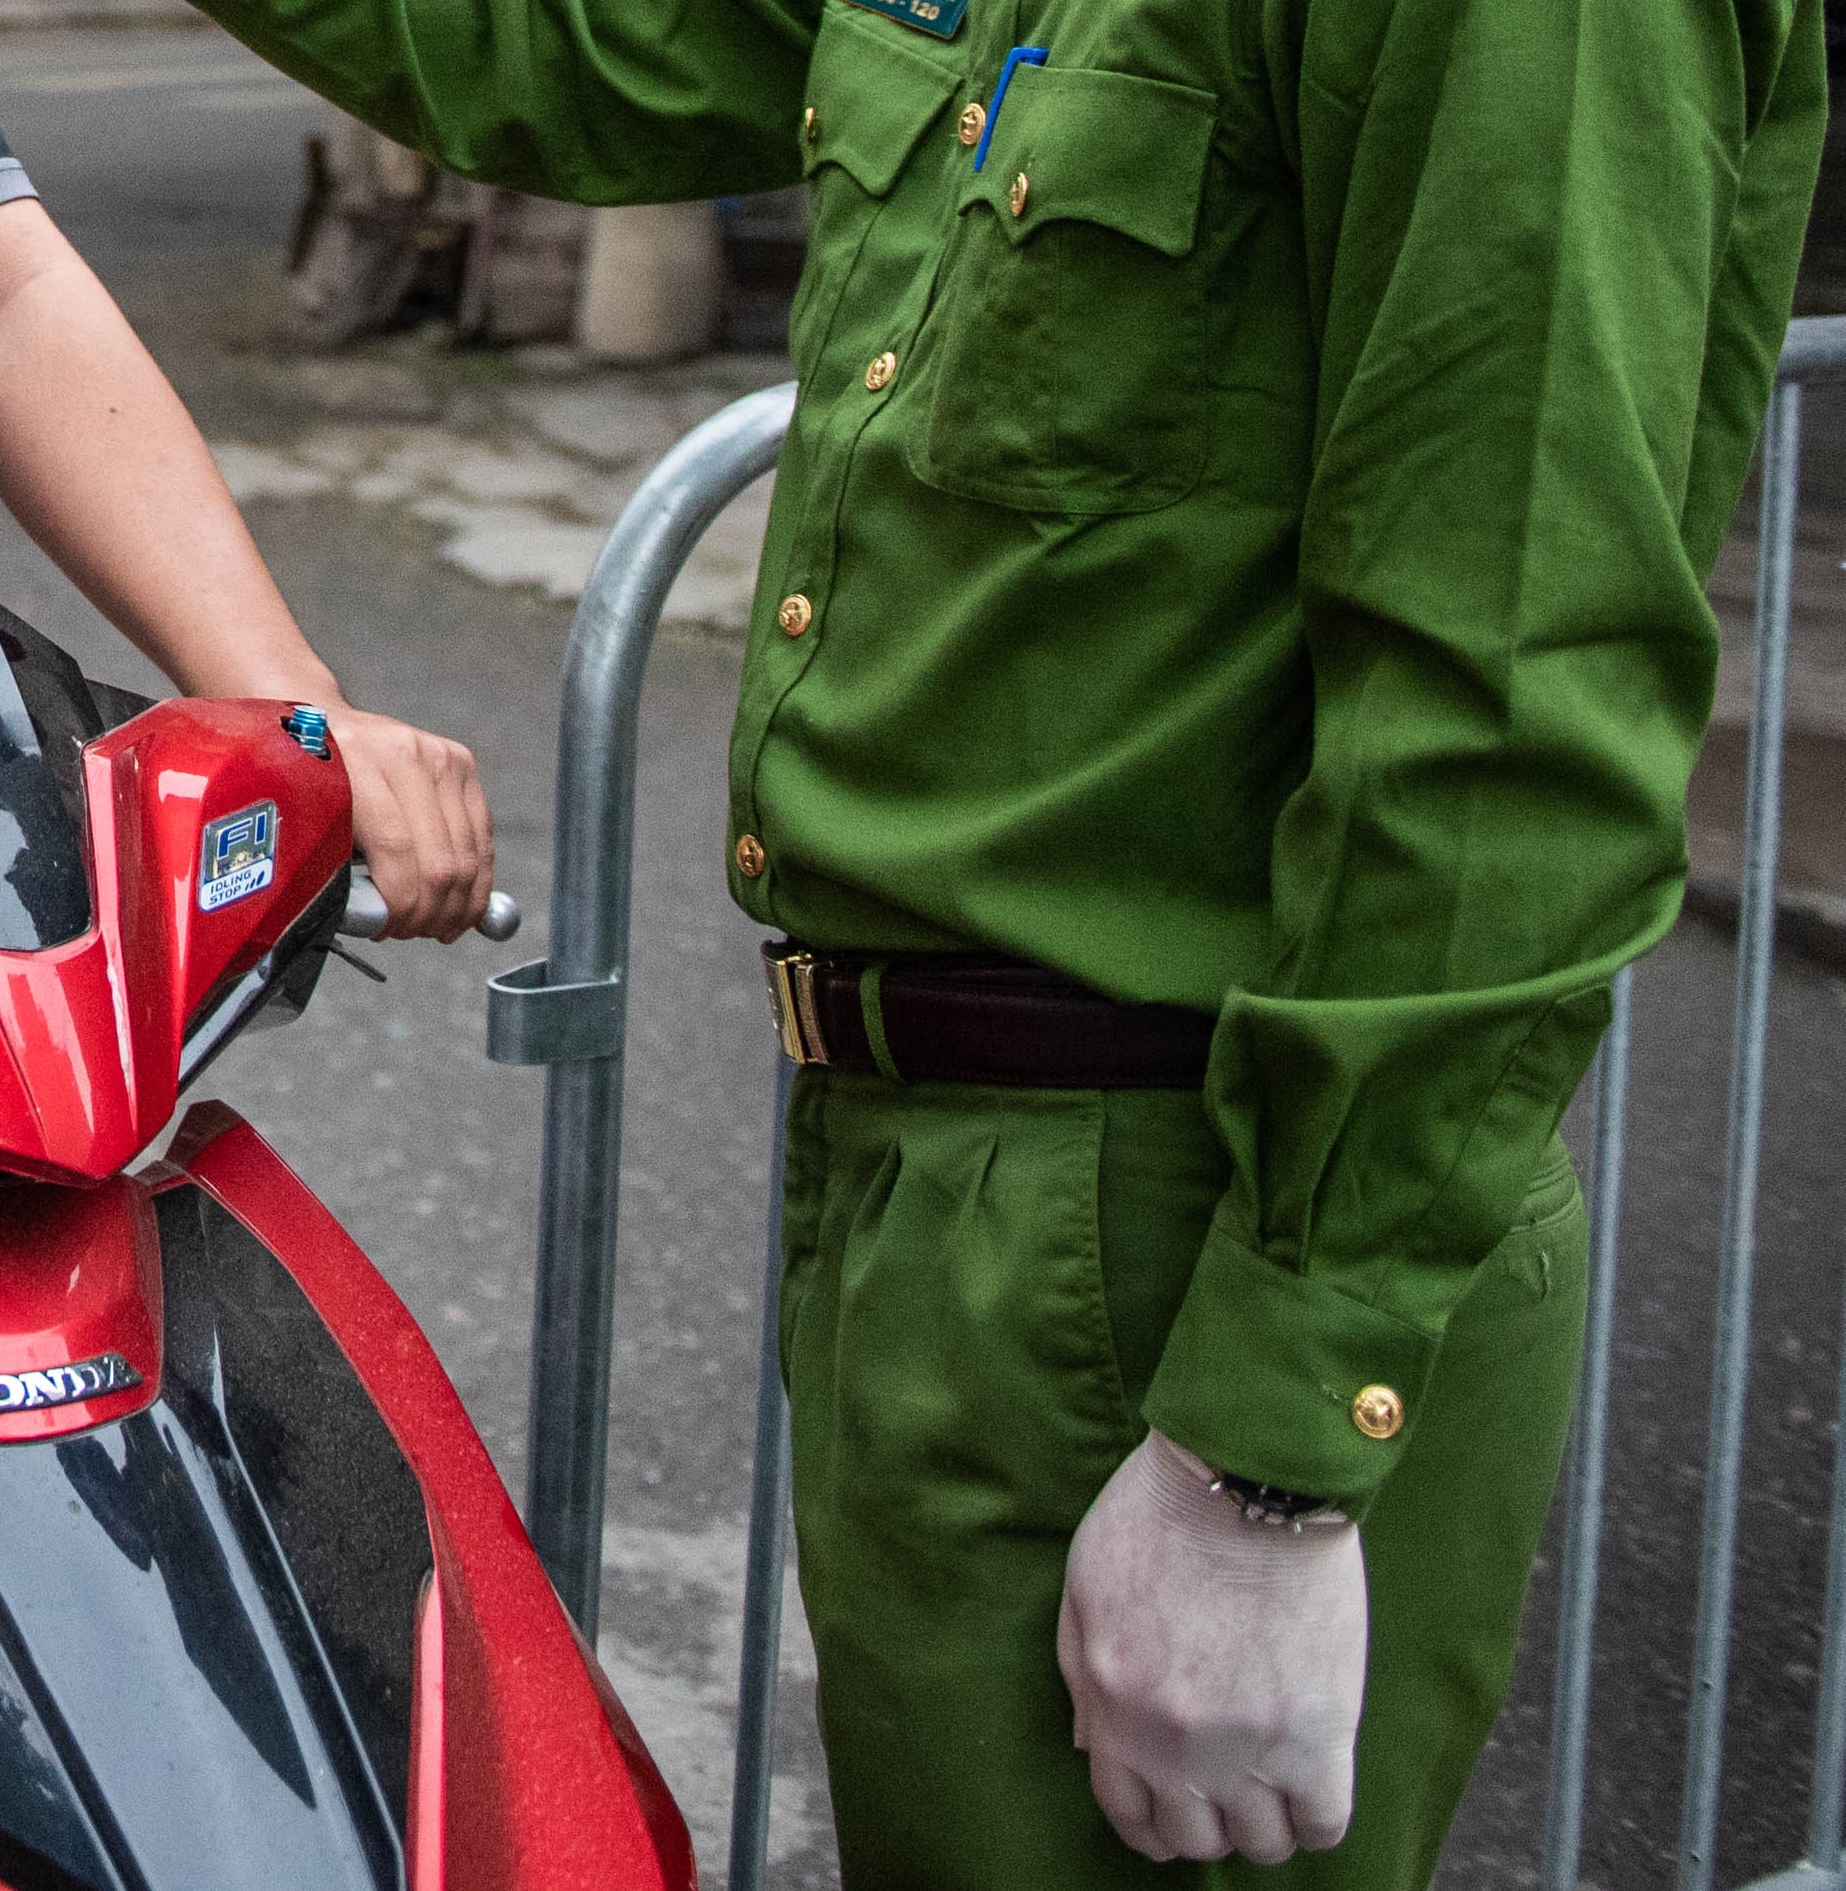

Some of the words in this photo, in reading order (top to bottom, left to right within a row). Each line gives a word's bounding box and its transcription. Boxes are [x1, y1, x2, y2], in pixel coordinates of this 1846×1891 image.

[217, 811, 268, 861] FI
[210, 870, 252, 894] IDLING
[209, 885, 243, 905] STOP
